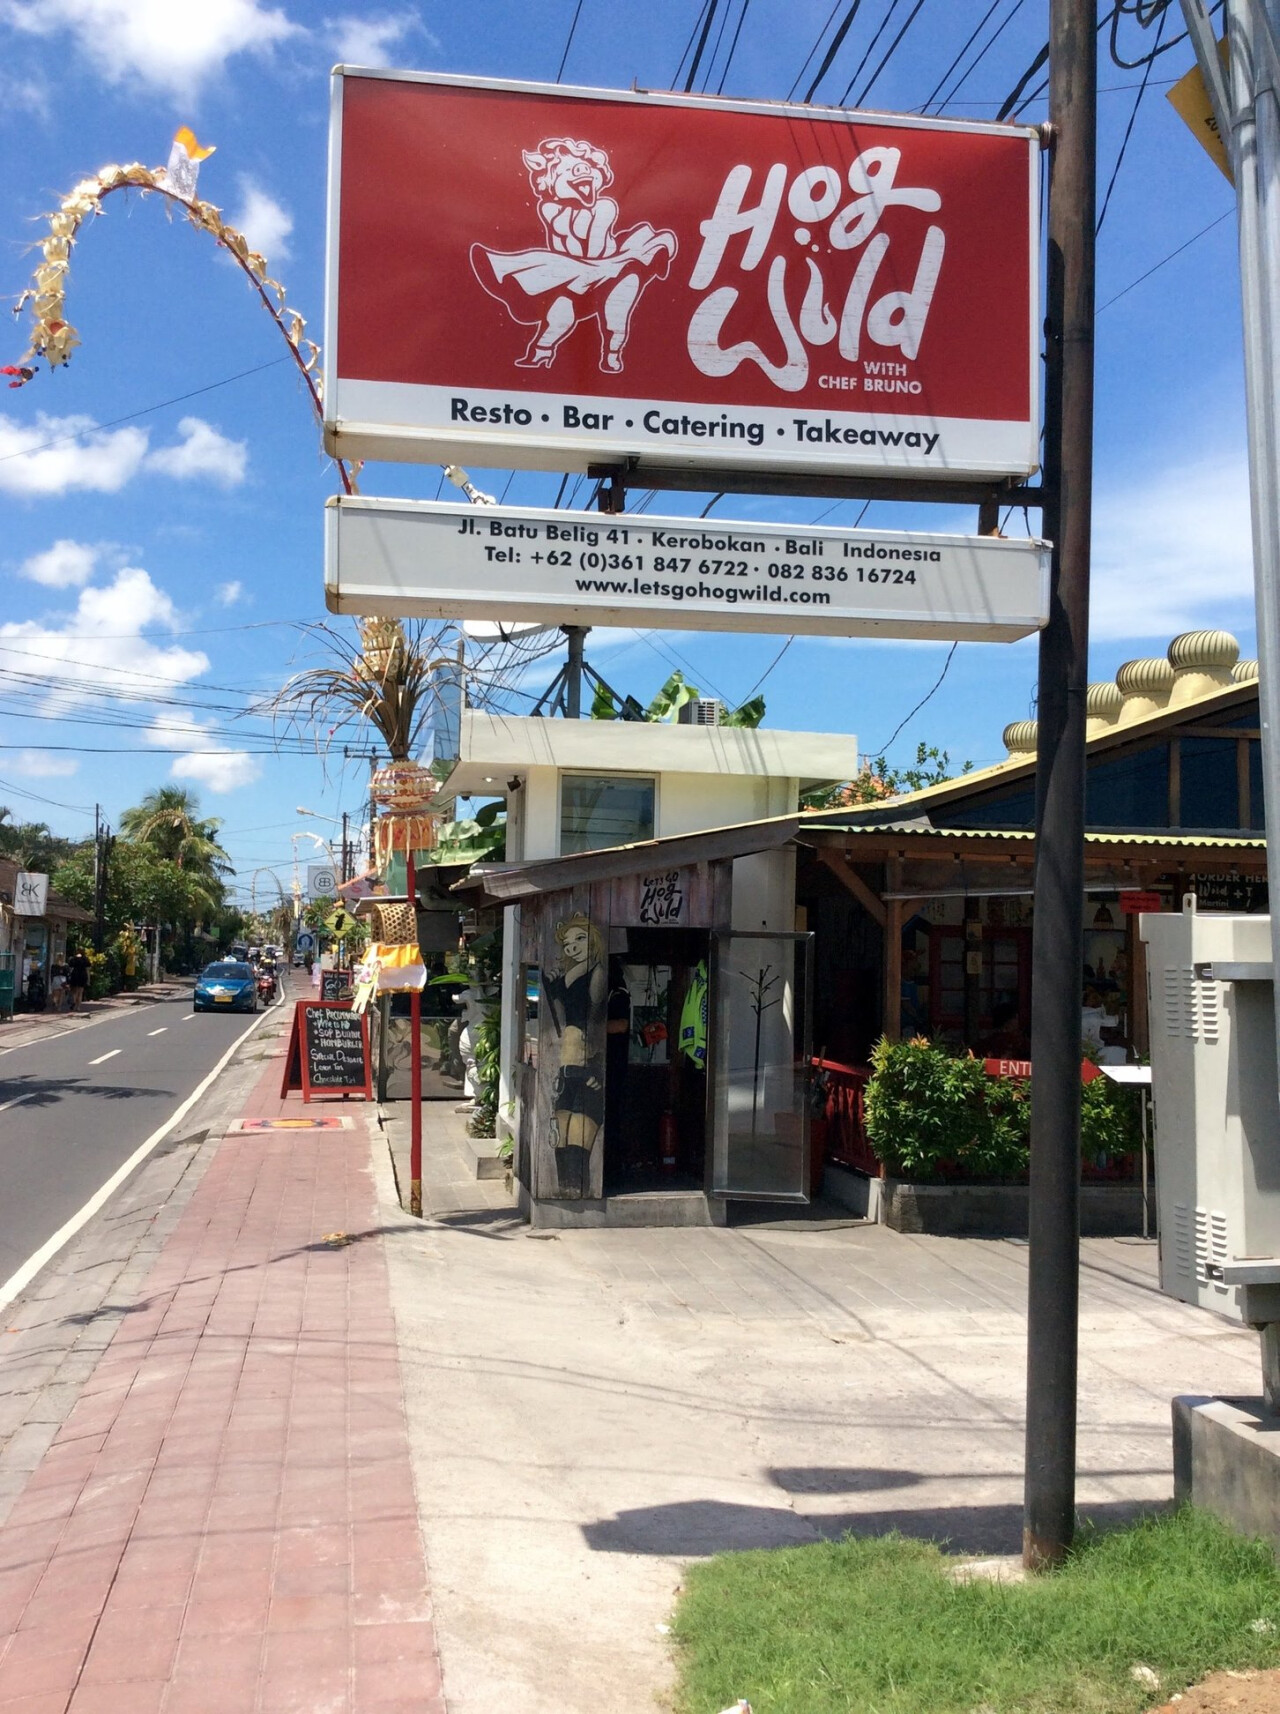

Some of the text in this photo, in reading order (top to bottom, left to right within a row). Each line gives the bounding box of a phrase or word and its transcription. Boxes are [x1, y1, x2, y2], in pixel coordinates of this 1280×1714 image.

[687, 145, 942, 290] Hog
[687, 225, 946, 392] Wild
[863, 361, 907, 377] WITH
[818, 375, 922, 395] CHEF BRUNO
[451, 397, 940, 455] Resto Bar Catering Takeaway
[457, 518, 941, 562] Jl. Batu Belig 41 Kerobokan Bali Indonesia
[484, 546, 917, 585] Tel: +62 (0)361 847 6722 082 836 16724
[575, 577, 830, 605] www.letsgohogwild.com
[639, 896, 683, 925] Wild
[640, 883, 682, 909] Hog
[1000, 1060, 1032, 1076] ENT
